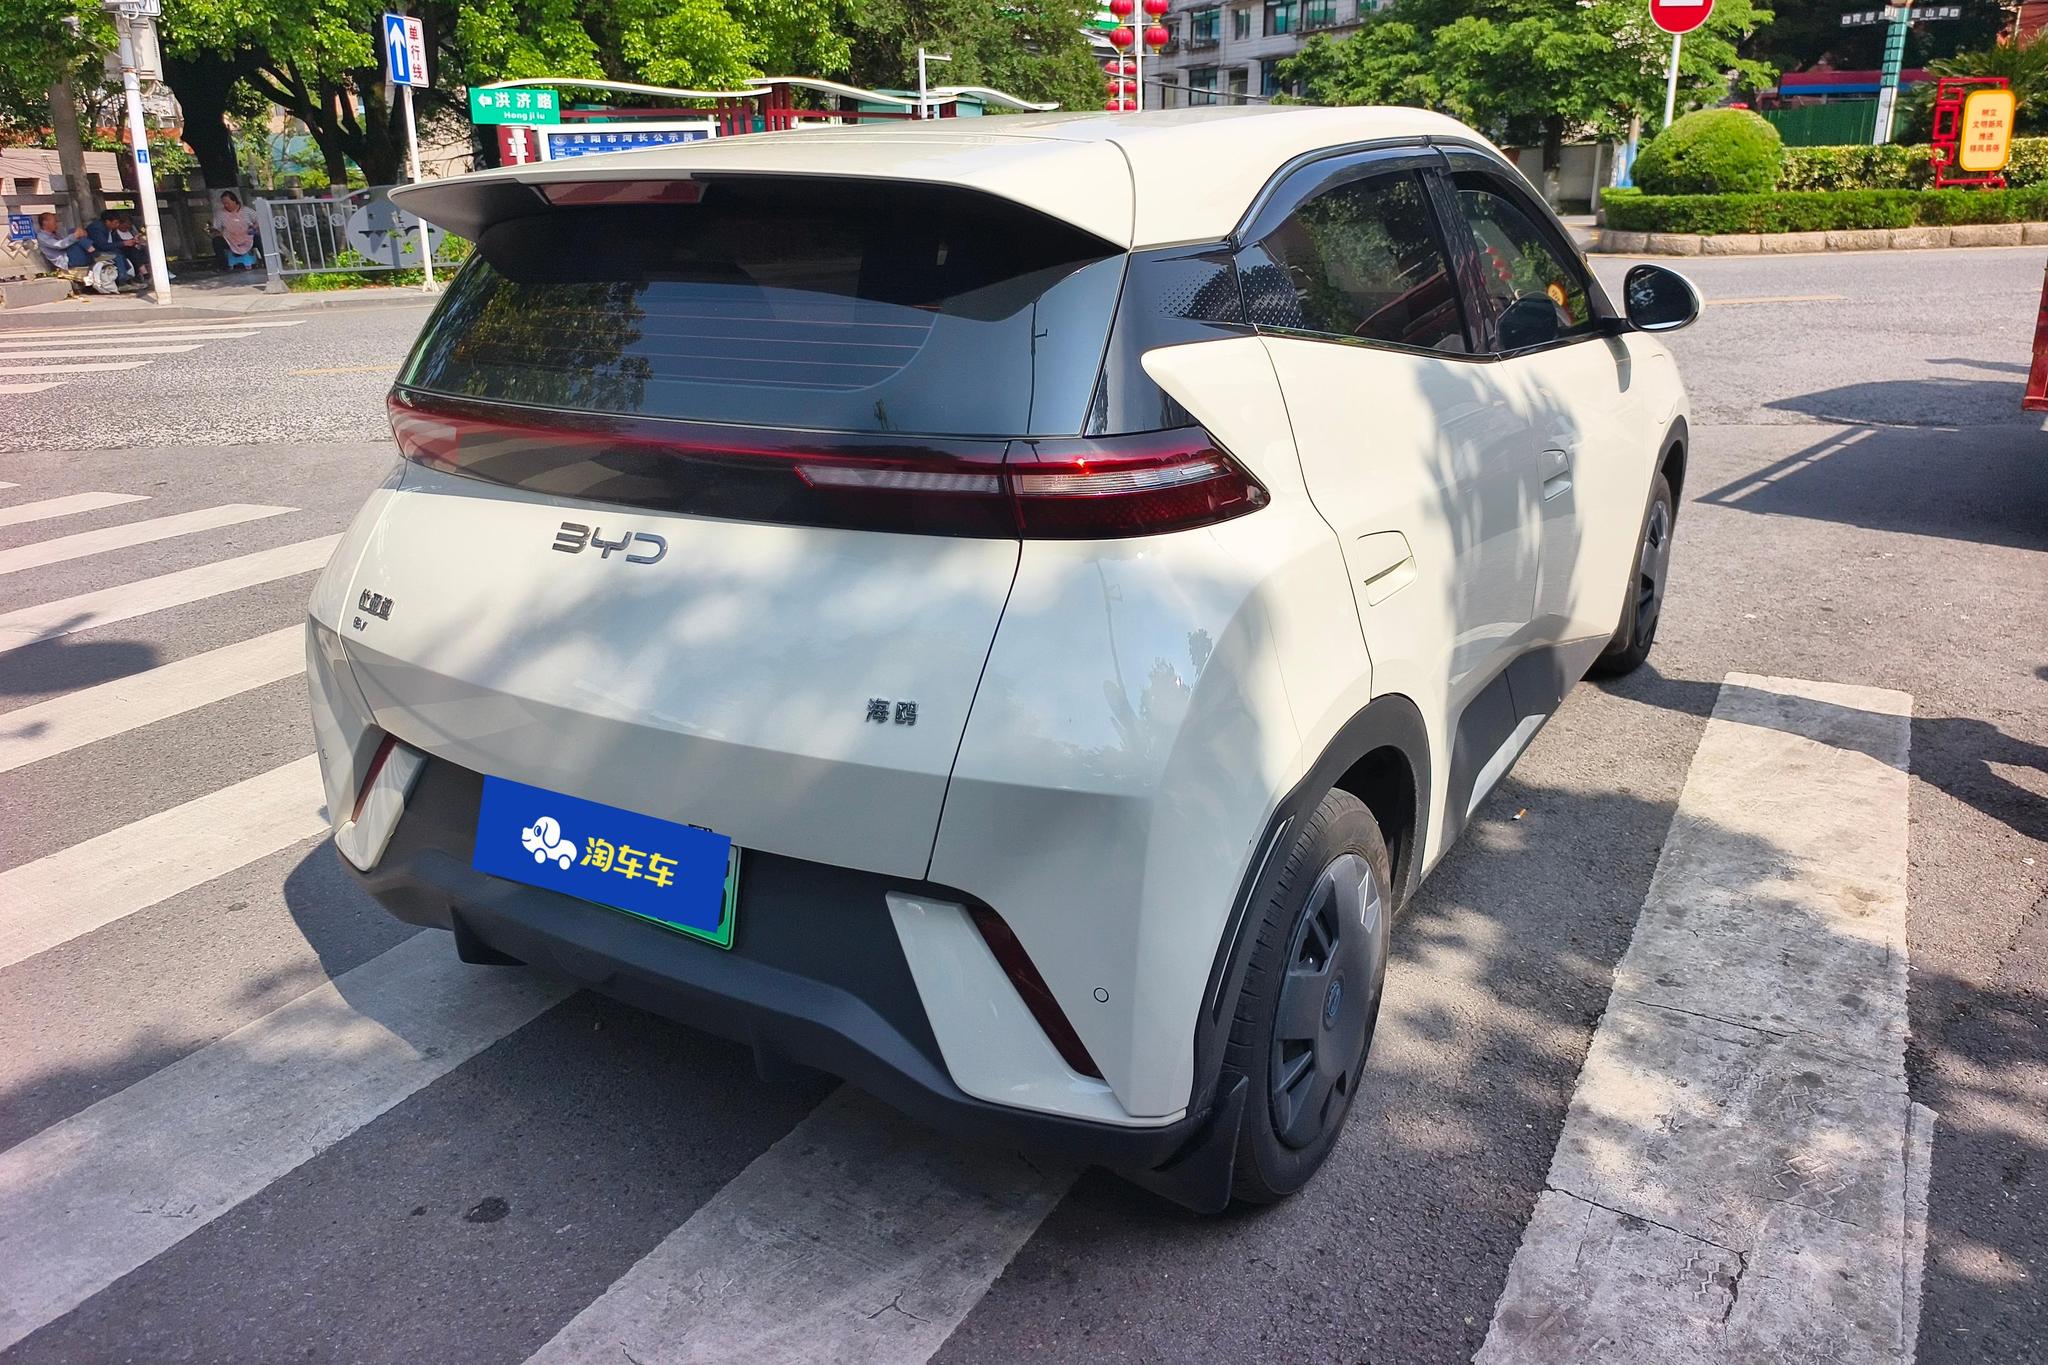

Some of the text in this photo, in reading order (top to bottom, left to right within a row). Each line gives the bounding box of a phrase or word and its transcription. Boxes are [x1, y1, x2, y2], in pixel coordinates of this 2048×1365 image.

[409, 25, 423, 80] 单行线
[495, 91, 553, 110] 洪济路
[503, 111, 528, 121] Hong
[552, 521, 669, 566] BYD
[865, 697, 918, 726] 海鸥
